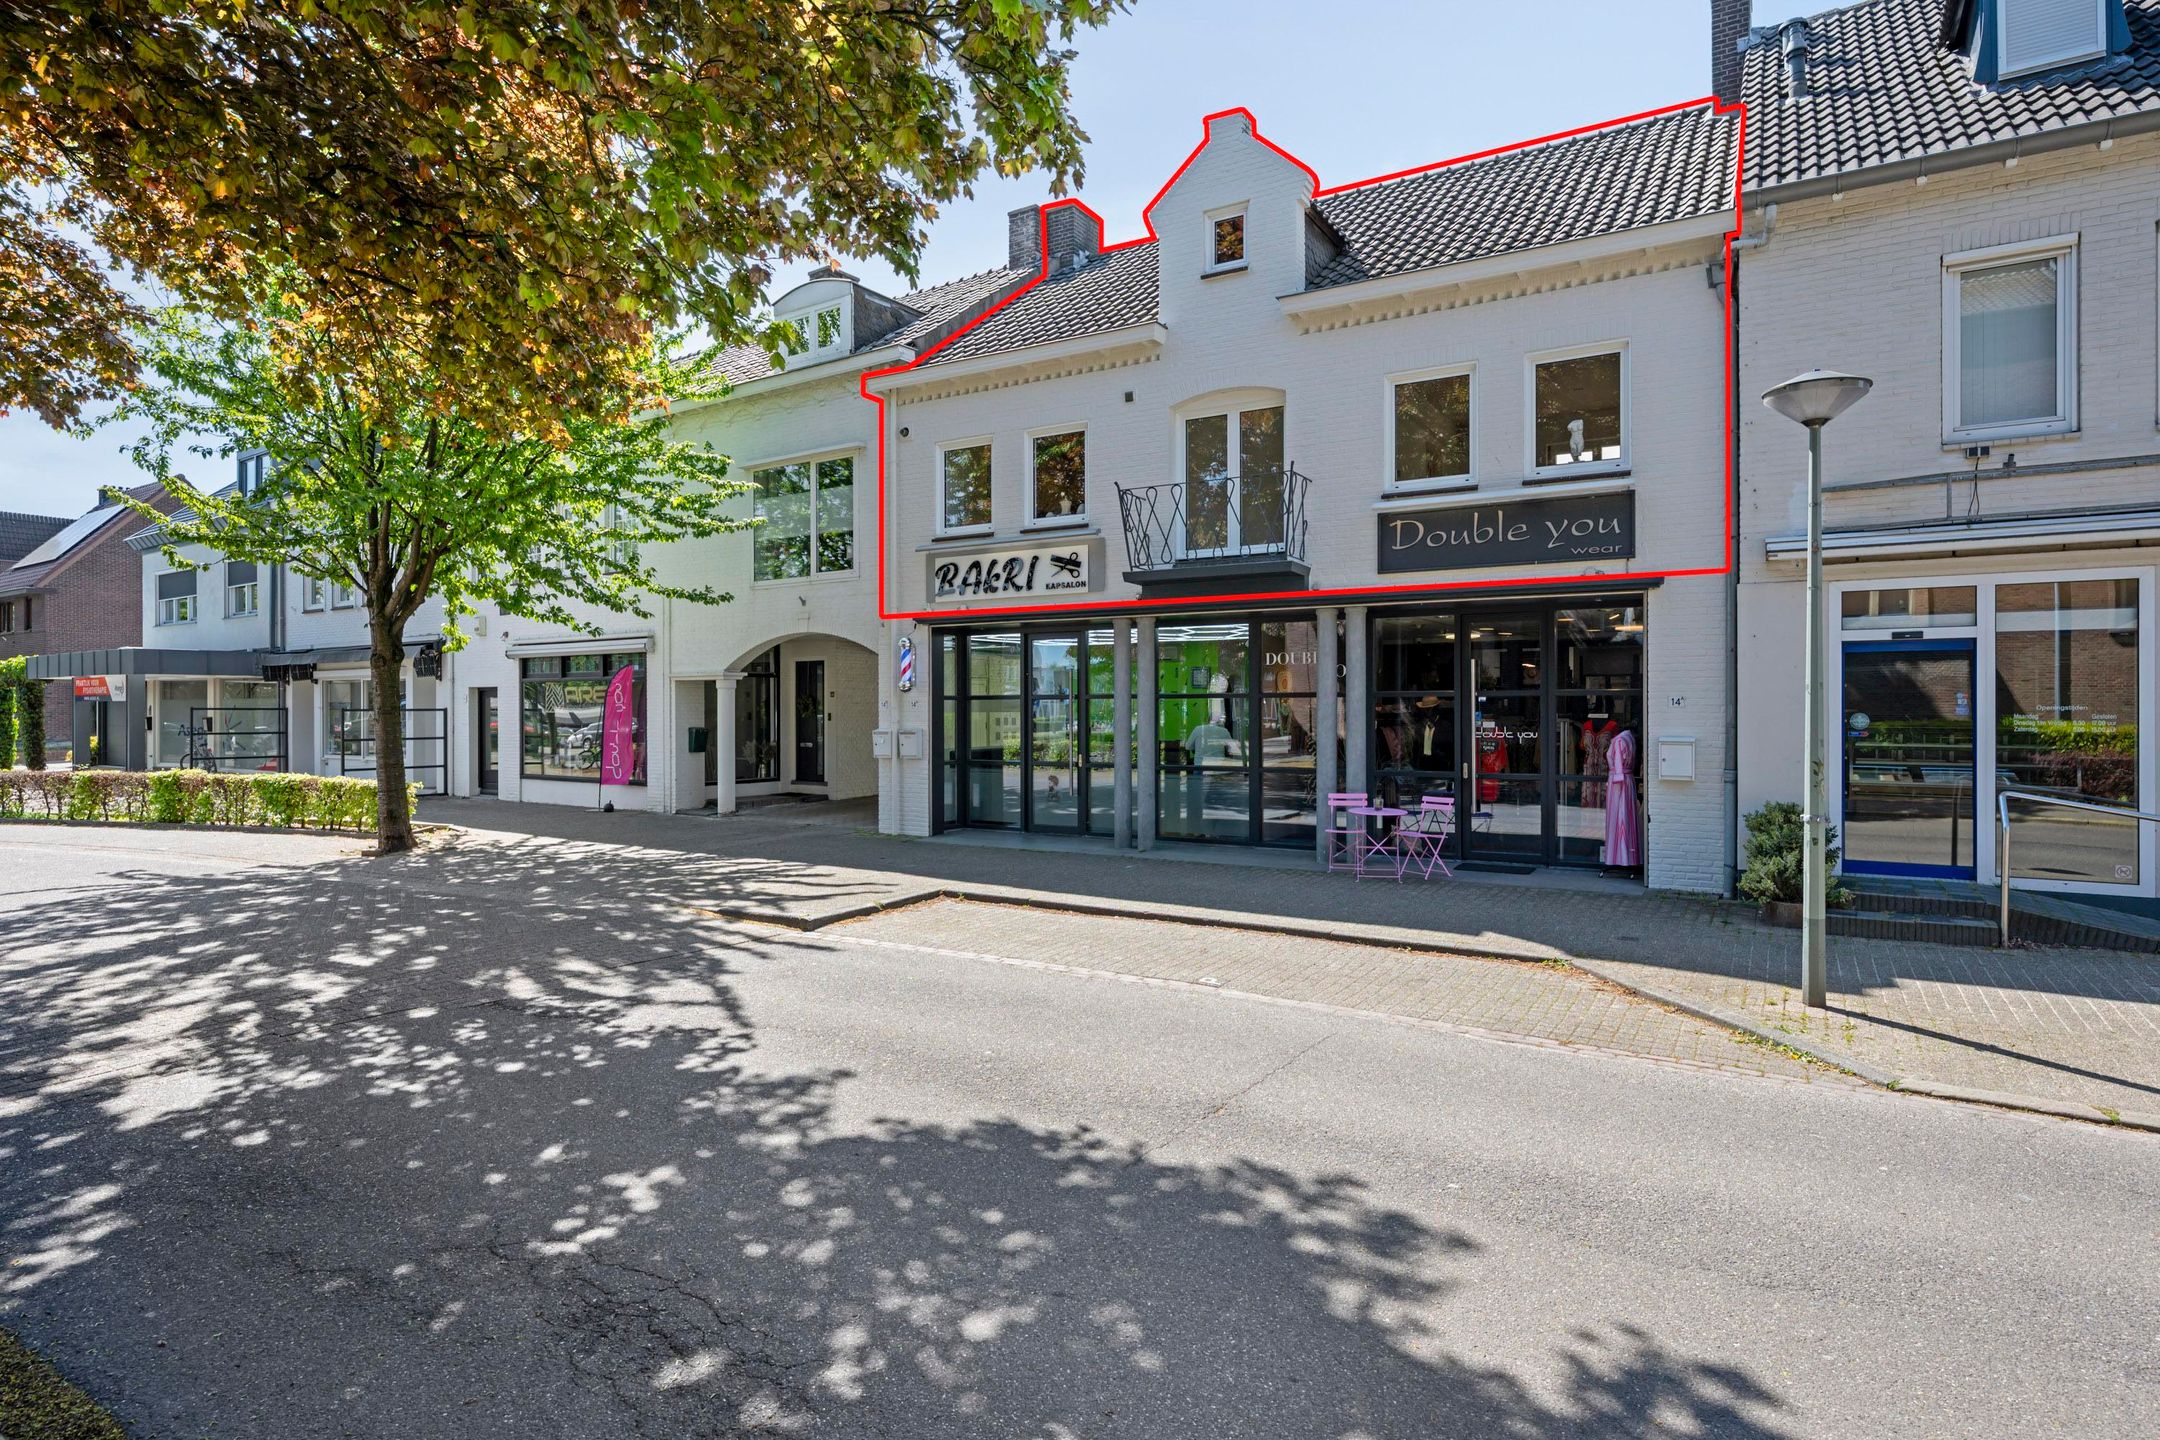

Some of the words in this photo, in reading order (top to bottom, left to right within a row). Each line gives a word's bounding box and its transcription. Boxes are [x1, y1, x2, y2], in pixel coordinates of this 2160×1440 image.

[1389, 510, 1530, 550] Double
[1545, 517, 1621, 549] you
[1571, 544, 1623, 554] wear
[1045, 581, 1087, 590] KAPSALON
[1517, 732, 1538, 744] you
